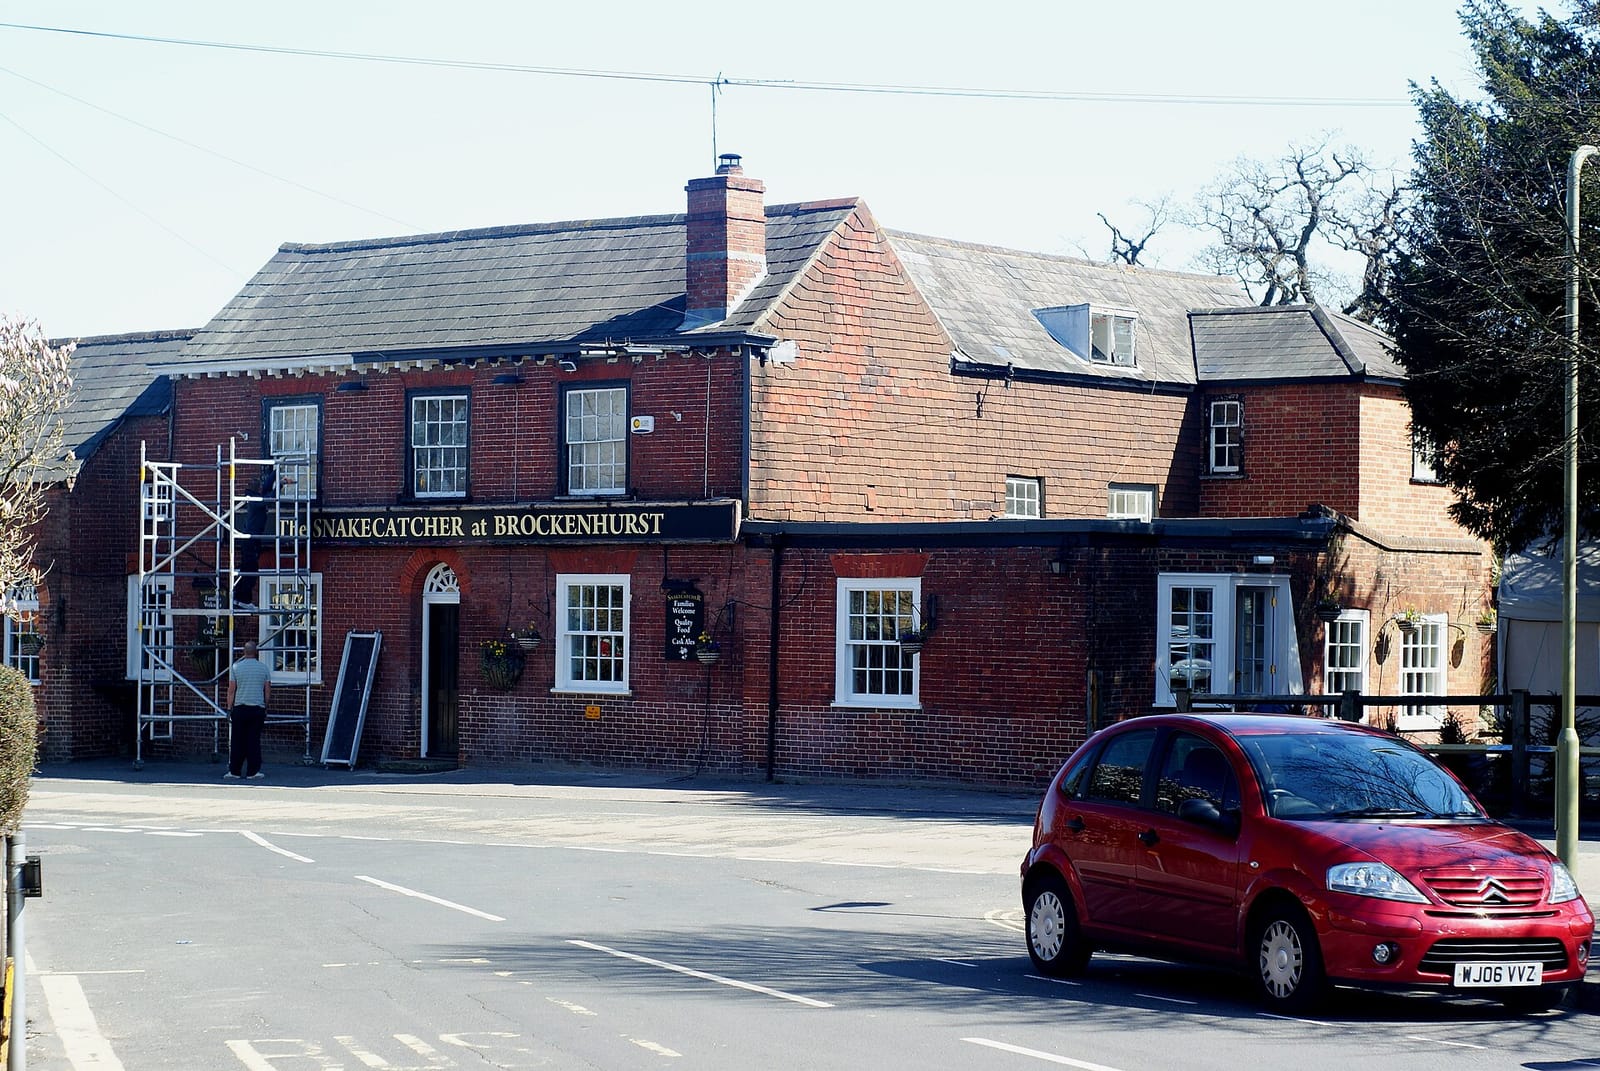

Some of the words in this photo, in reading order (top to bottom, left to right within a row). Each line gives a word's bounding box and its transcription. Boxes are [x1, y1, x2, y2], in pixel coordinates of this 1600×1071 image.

[313, 516, 465, 538] SNAKECATCHER
[471, 518, 488, 536] at
[494, 513, 664, 536] BROCKENHURST
[674, 618, 693, 627] Quality
[1462, 966, 1502, 983] WJ06
[1508, 965, 1536, 982] VVZ
